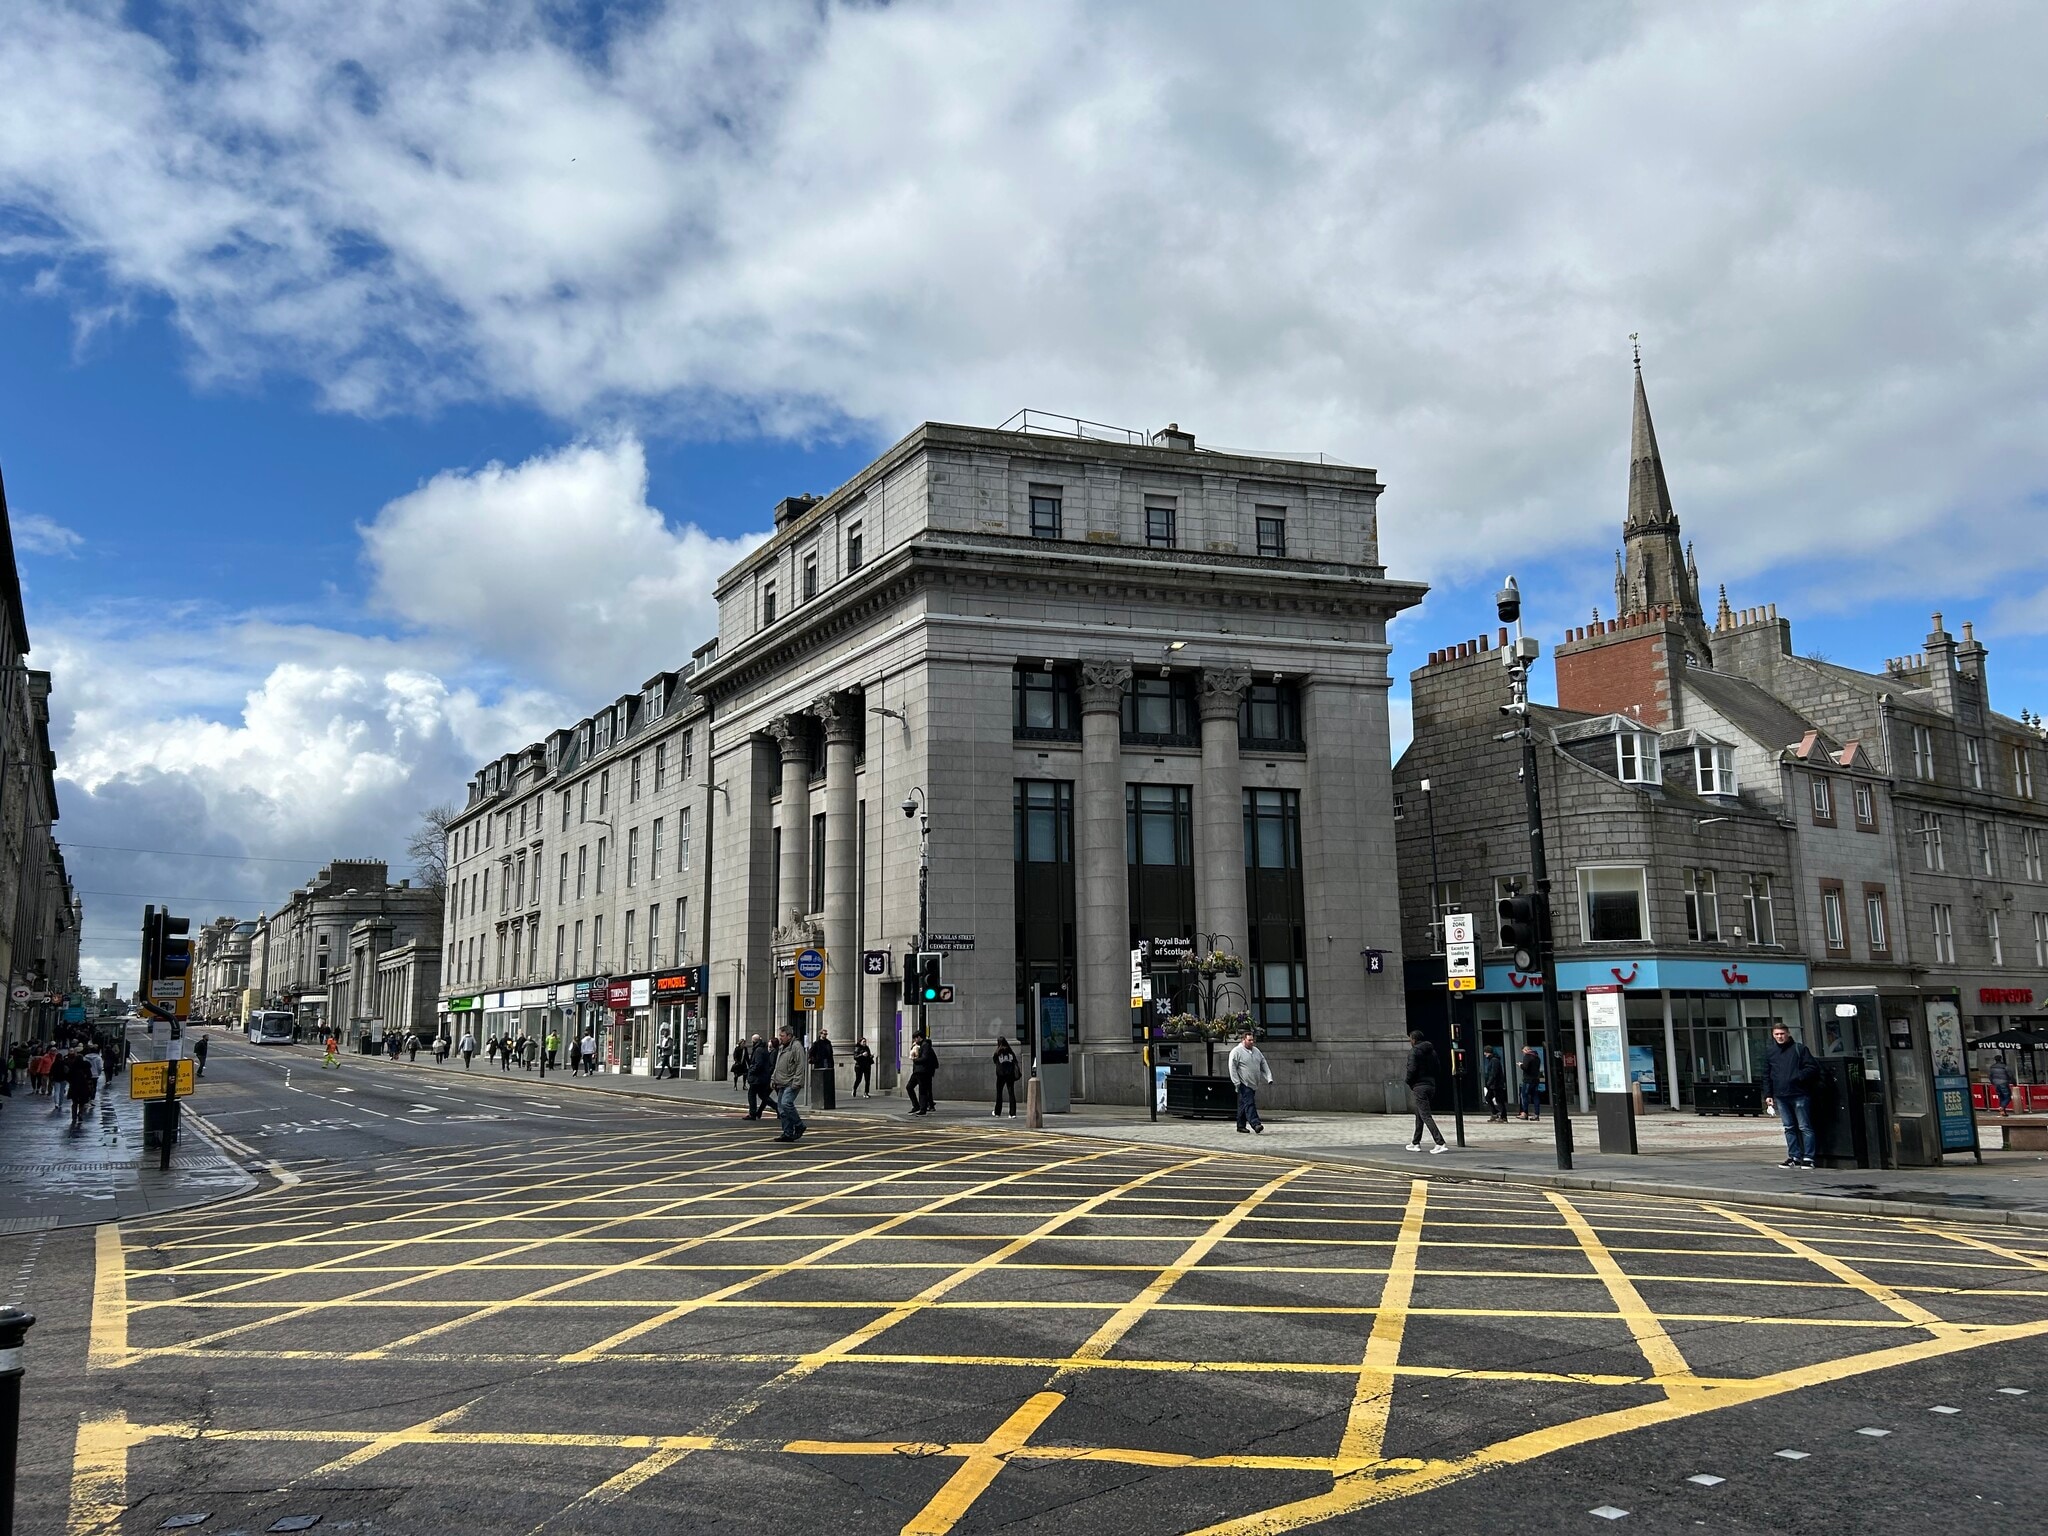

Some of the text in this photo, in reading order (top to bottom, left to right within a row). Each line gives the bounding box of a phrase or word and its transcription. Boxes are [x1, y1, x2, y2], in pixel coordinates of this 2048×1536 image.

[1154, 937, 1190, 947] Royal Bank
[1998, 1042, 2022, 1050] GUYS
[1943, 1091, 1962, 1104] FEES
[1945, 1102, 1963, 1112] LOANS
